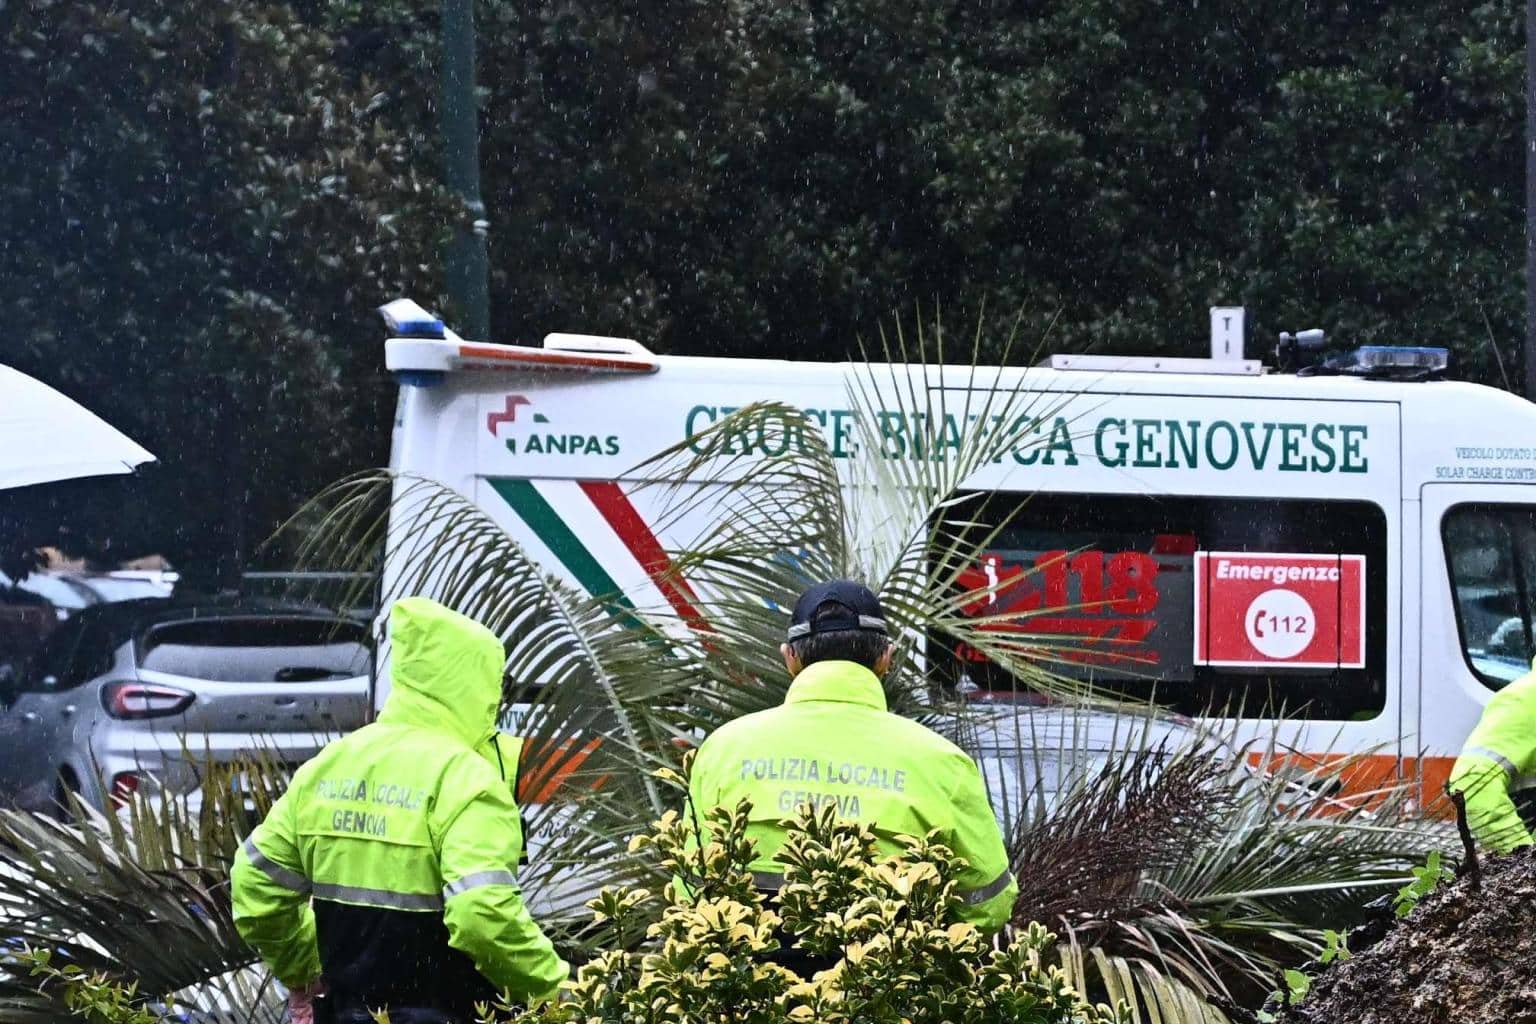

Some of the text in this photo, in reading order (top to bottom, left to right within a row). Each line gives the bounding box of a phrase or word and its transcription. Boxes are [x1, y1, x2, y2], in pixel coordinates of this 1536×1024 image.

[524, 433, 620, 456] ANPAS
[1094, 416, 1369, 474] GENOVESE
[1435, 466, 1464, 478] SOLAR
[1466, 467, 1503, 479] CHARGE
[1034, 550, 1160, 616] 118
[1269, 615, 1307, 634] 112
[740, 757, 907, 793] POLIZIA LOCALE
